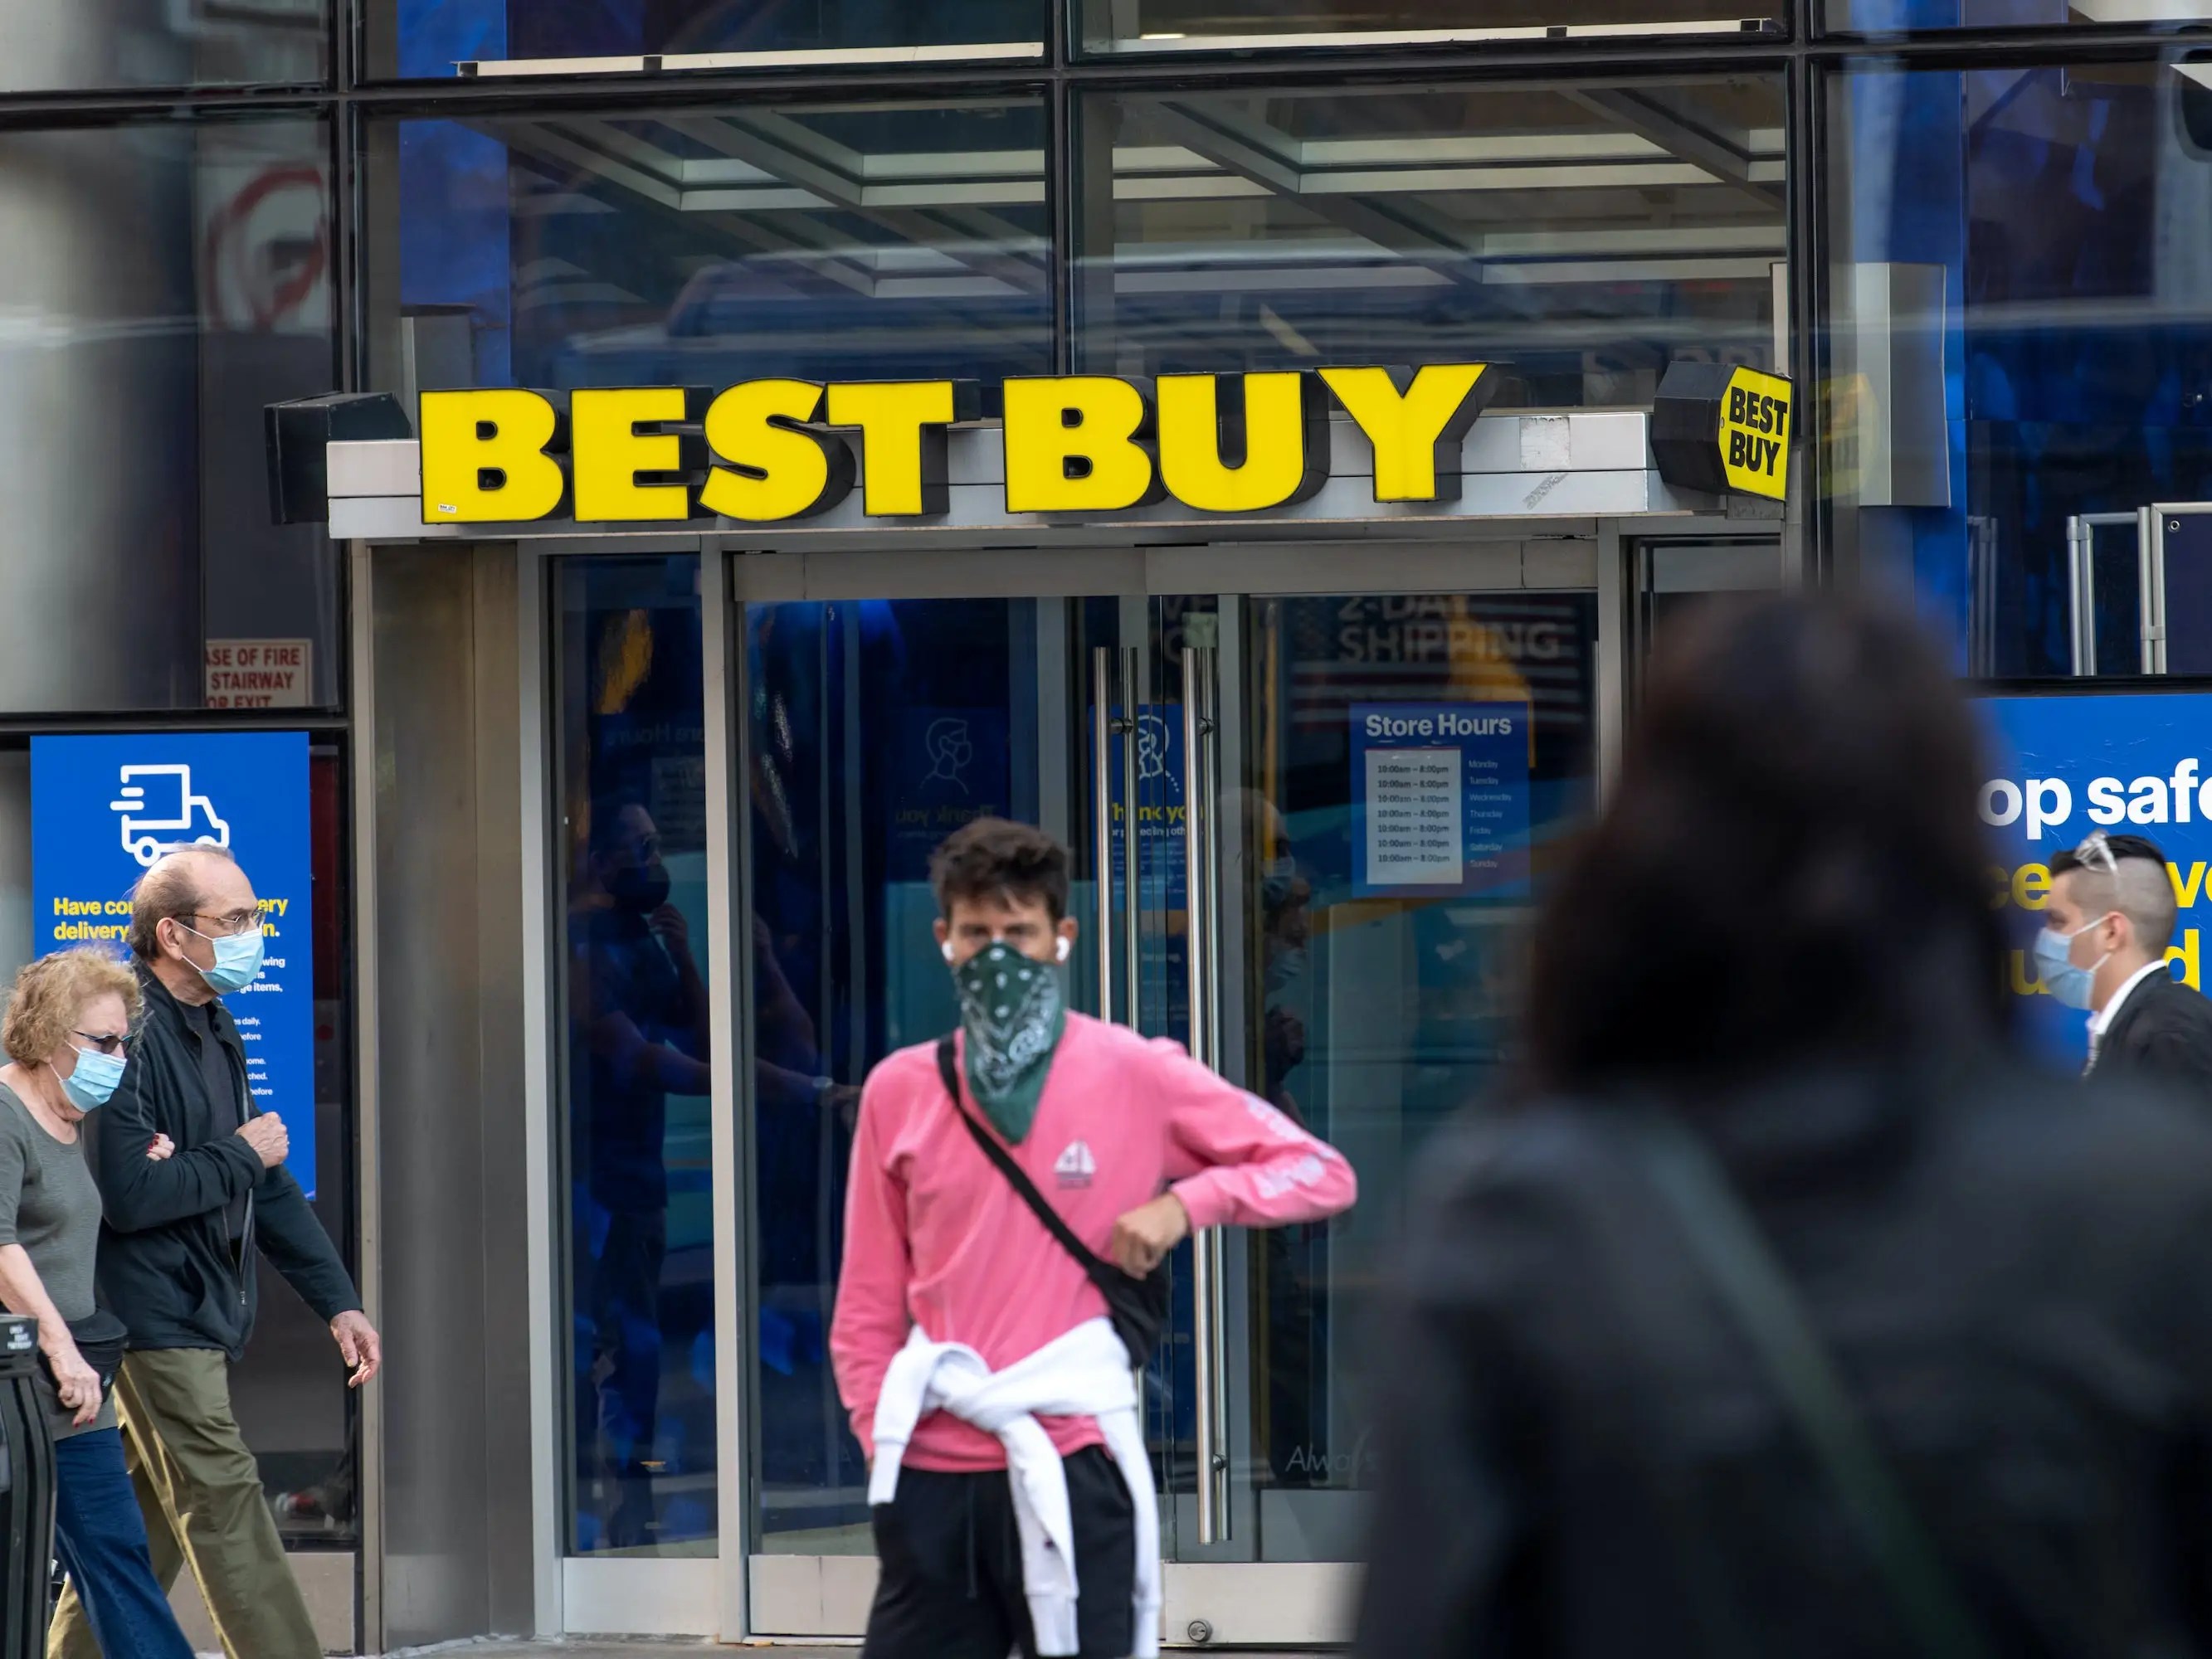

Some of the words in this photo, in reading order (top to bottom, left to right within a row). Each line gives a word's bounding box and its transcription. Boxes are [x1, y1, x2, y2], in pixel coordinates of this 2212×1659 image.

[1728, 386, 1788, 436] BEST
[420, 377, 954, 523] BEST
[1003, 362, 1487, 513] BUY
[1728, 429, 1781, 477] BUY
[1337, 621, 1560, 664] SHIPPING
[237, 648, 259, 666] OF
[263, 648, 300, 666] FIRE
[211, 671, 294, 690] STAIRWAY
[1366, 713, 1433, 737] Store
[1438, 713, 1513, 736] Hours
[1977, 776, 2073, 840] op
[53, 898, 102, 916] Have
[53, 921, 129, 942] delivery
[253, 982, 283, 993] items,
[241, 1017, 261, 1027] daily.
[247, 1072, 268, 1080] ched.
